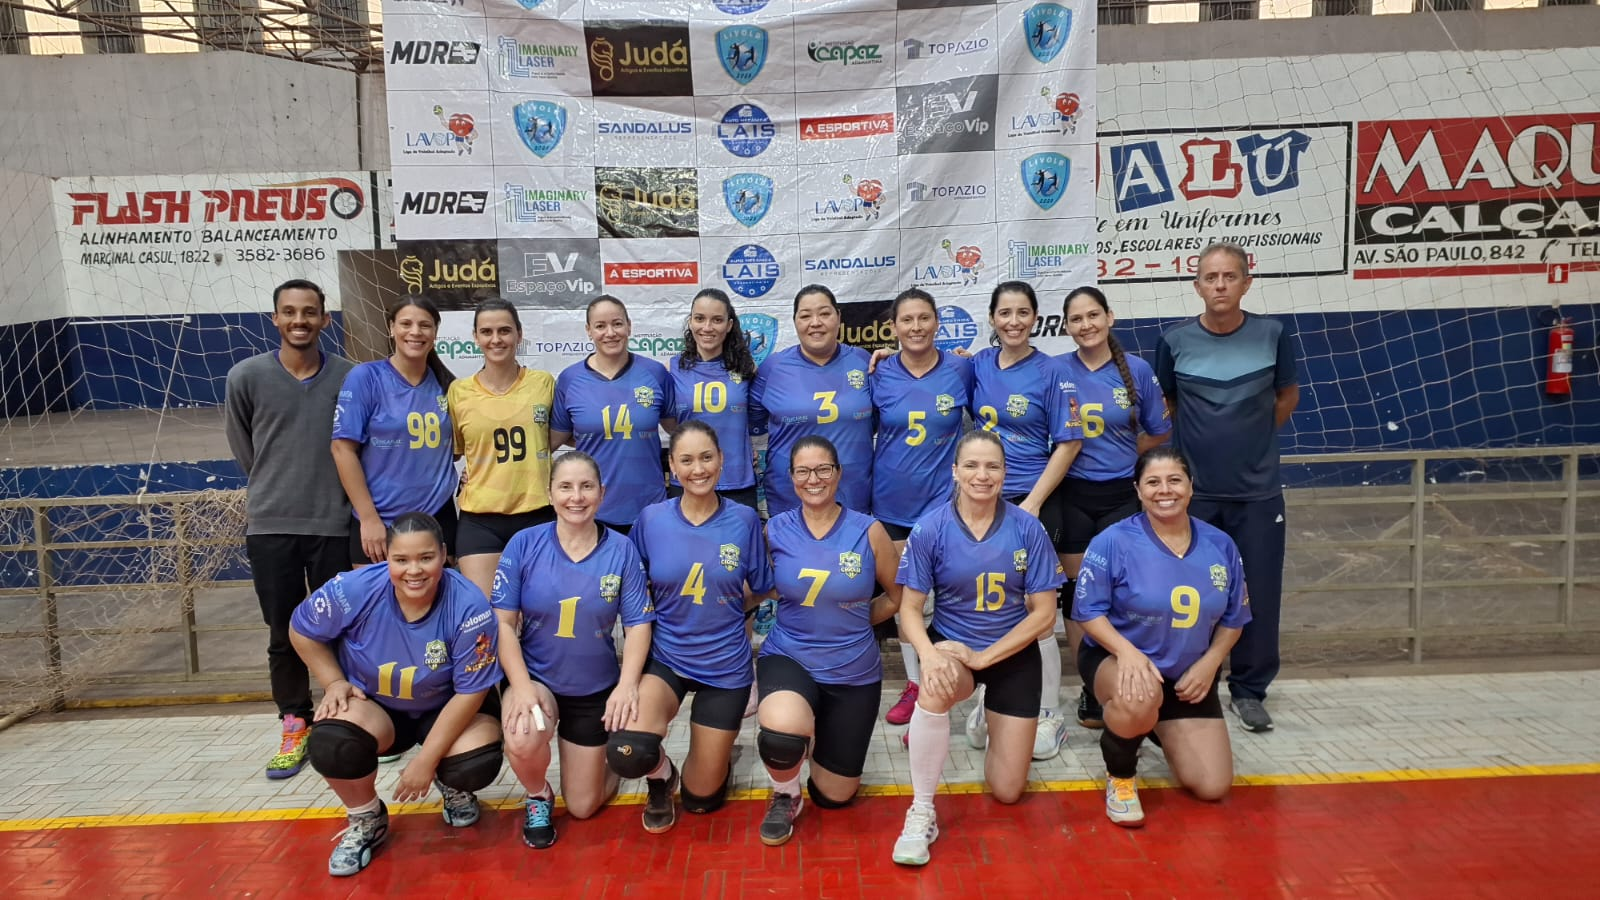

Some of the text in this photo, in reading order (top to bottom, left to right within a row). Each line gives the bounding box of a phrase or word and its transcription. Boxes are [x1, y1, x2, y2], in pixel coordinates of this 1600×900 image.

[518, 44, 578, 57] IMAGINARY
[619, 38, 688, 66] Judá
[816, 44, 883, 66] capaz
[928, 38, 989, 54] TOPAZIO
[519, 56, 555, 68] LASER
[598, 122, 692, 134] SANDALUS
[718, 124, 776, 138] LAIS
[805, 120, 889, 134] A ESPORTIVA
[1363, 124, 1600, 195] MAQU
[525, 190, 587, 201] IMAGINARY
[931, 185, 986, 197] TOPAZIO
[66, 188, 328, 225] FLASH PNEUS
[526, 201, 561, 212] LASER
[1115, 217, 1149, 232] em
[1160, 208, 1282, 233] Uniformes
[1370, 200, 1600, 238] CALÇA
[80, 227, 338, 245] ALINHAMENTO BALANCEAMENTO
[1120, 236, 1203, 253] ESCOLARES
[80, 248, 326, 265] MARGINAL CASUL, 1822 3582-3686
[1028, 243, 1089, 257] IMAGINARY
[1028, 256, 1062, 267] LASER
[1354, 249, 1379, 265] AV.
[1384, 244, 1419, 264] SÃO
[1427, 246, 1487, 263] PAULO,
[1490, 244, 1525, 260] 842
[428, 257, 496, 281] Judá
[524, 252, 580, 278] EV
[609, 267, 693, 279] A ESPORTIVA
[722, 263, 780, 279] LAIS
[805, 256, 896, 271] SANDALUS
[837, 318, 897, 343] Judá
[936, 324, 978, 338] AIS
[437, 341, 484, 360] apa
[536, 342, 595, 353] TOPAZIO
[693, 381, 727, 413] 10
[813, 391, 840, 425] 3
[406, 412, 441, 449] 98
[601, 404, 634, 440] 14
[904, 411, 927, 447] 5
[979, 405, 1000, 440] 2
[1079, 403, 1105, 438] 6
[493, 425, 527, 464] 99
[680, 563, 707, 605] 4
[797, 568, 831, 607] 7
[975, 572, 1006, 611] 15
[554, 596, 581, 638] 1
[1170, 585, 1201, 629] 9
[375, 661, 419, 700] 11
